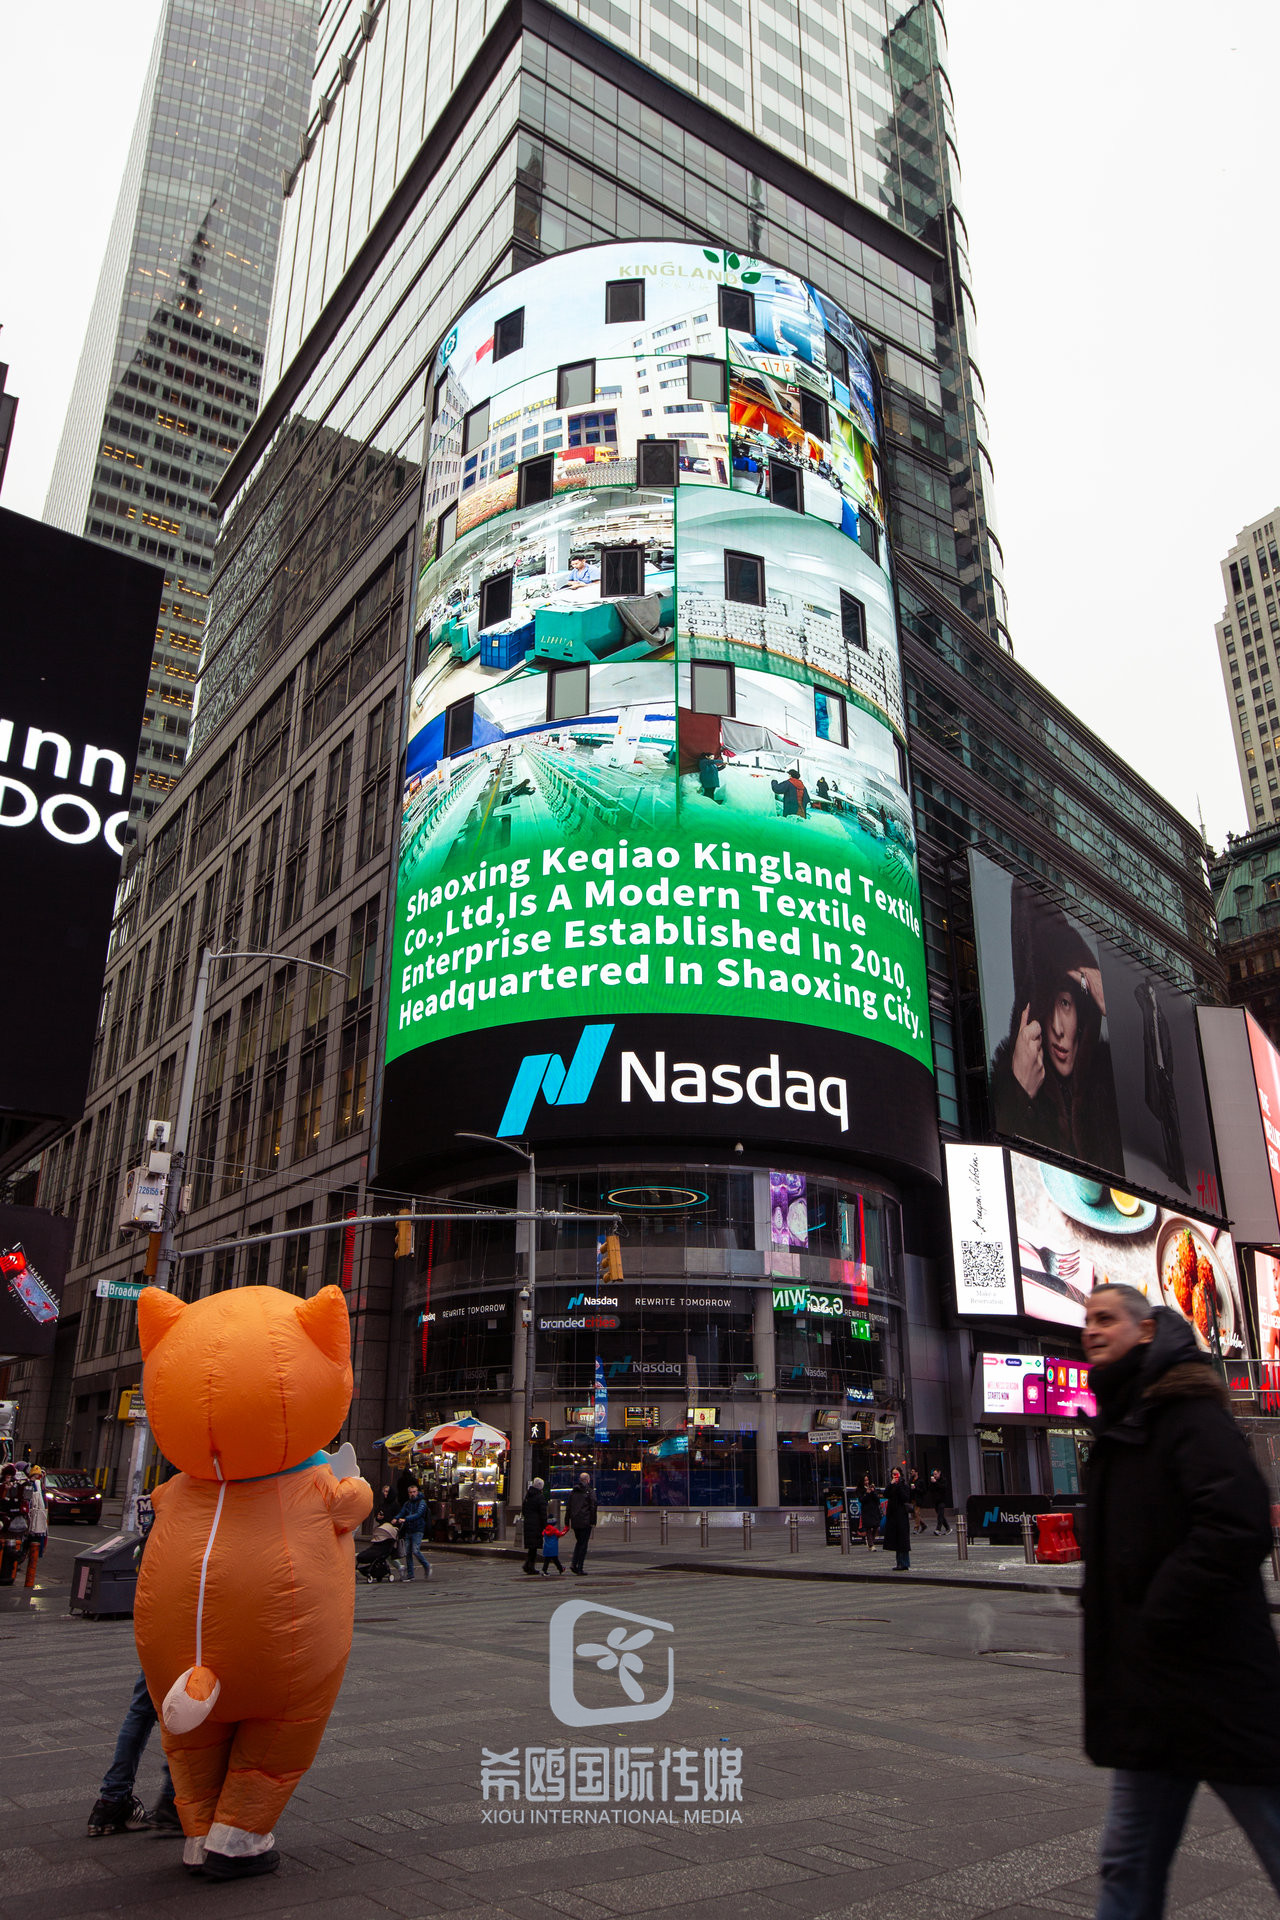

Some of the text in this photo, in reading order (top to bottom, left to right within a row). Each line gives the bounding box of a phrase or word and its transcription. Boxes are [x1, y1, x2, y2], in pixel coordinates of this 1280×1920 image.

[403, 876, 867, 957] Co.,Ltd,Is A Modern Textile
[405, 838, 921, 938] Shaoxing Keqiao Kingland Textile
[398, 953, 925, 1040] Headquartered In Shaoxing City.
[401, 914, 912, 1001] Enterprise Established In 2010,
[620, 1050, 849, 1133] Nasdaq
[442, 1307, 466, 1319] REWRITE
[467, 1303, 506, 1315] TOMORROW
[540, 1316, 616, 1330] brandedcities
[584, 1296, 732, 1307] Nasdaq REWRITE TOMORROW
[632, 1361, 682, 1376] Nasdaq
